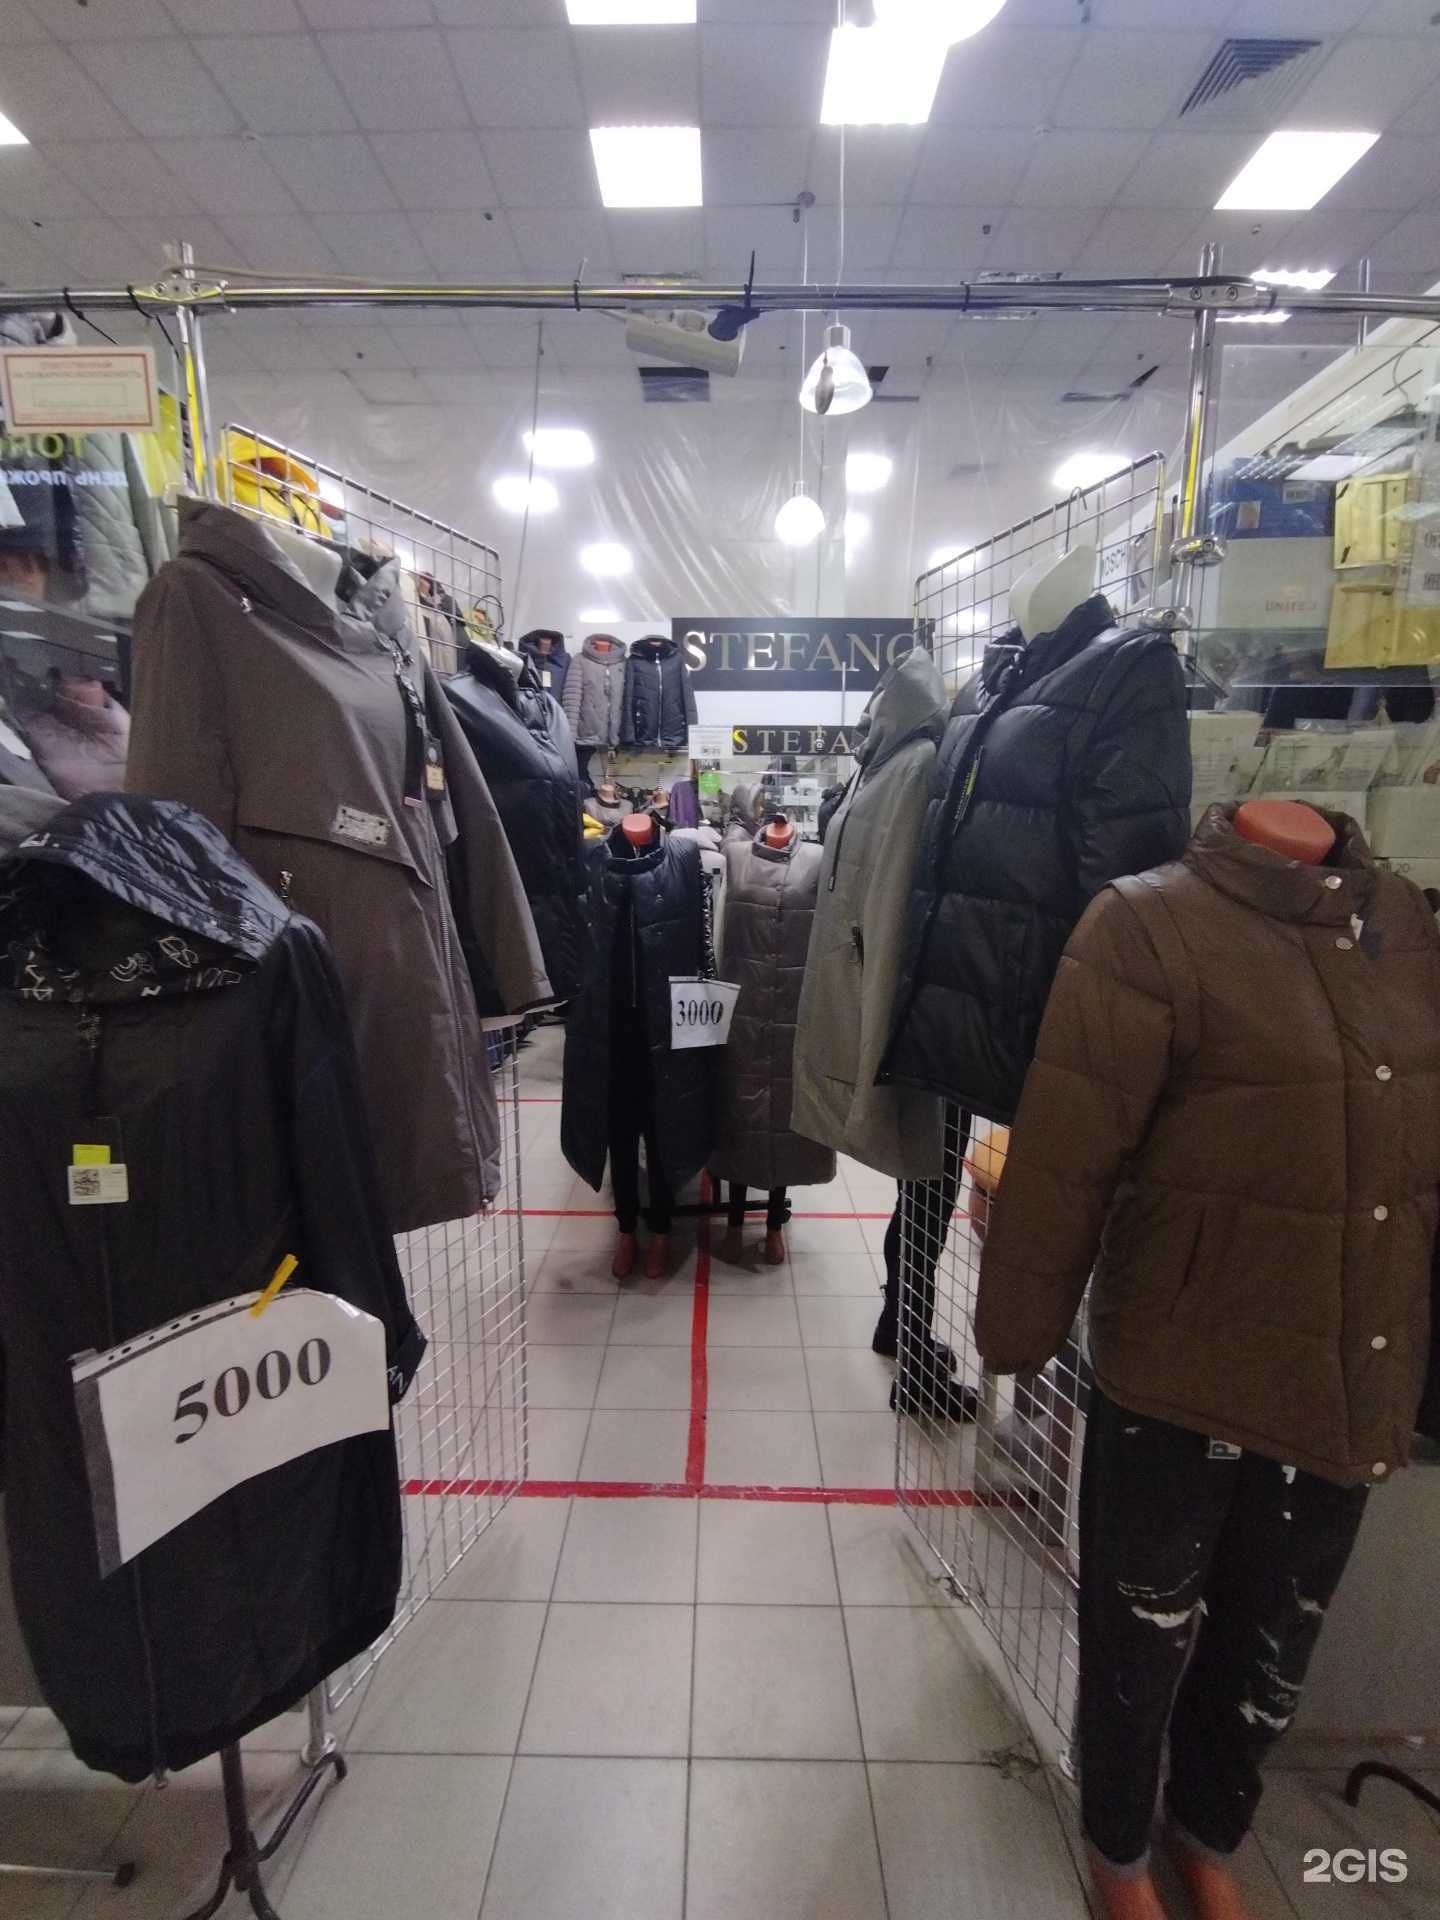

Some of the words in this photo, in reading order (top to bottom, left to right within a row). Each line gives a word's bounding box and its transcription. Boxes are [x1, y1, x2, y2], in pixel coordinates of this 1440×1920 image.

[731, 728, 852, 754] STEFA
[675, 999, 724, 1027] 3000
[174, 1337, 331, 1445] 5000
